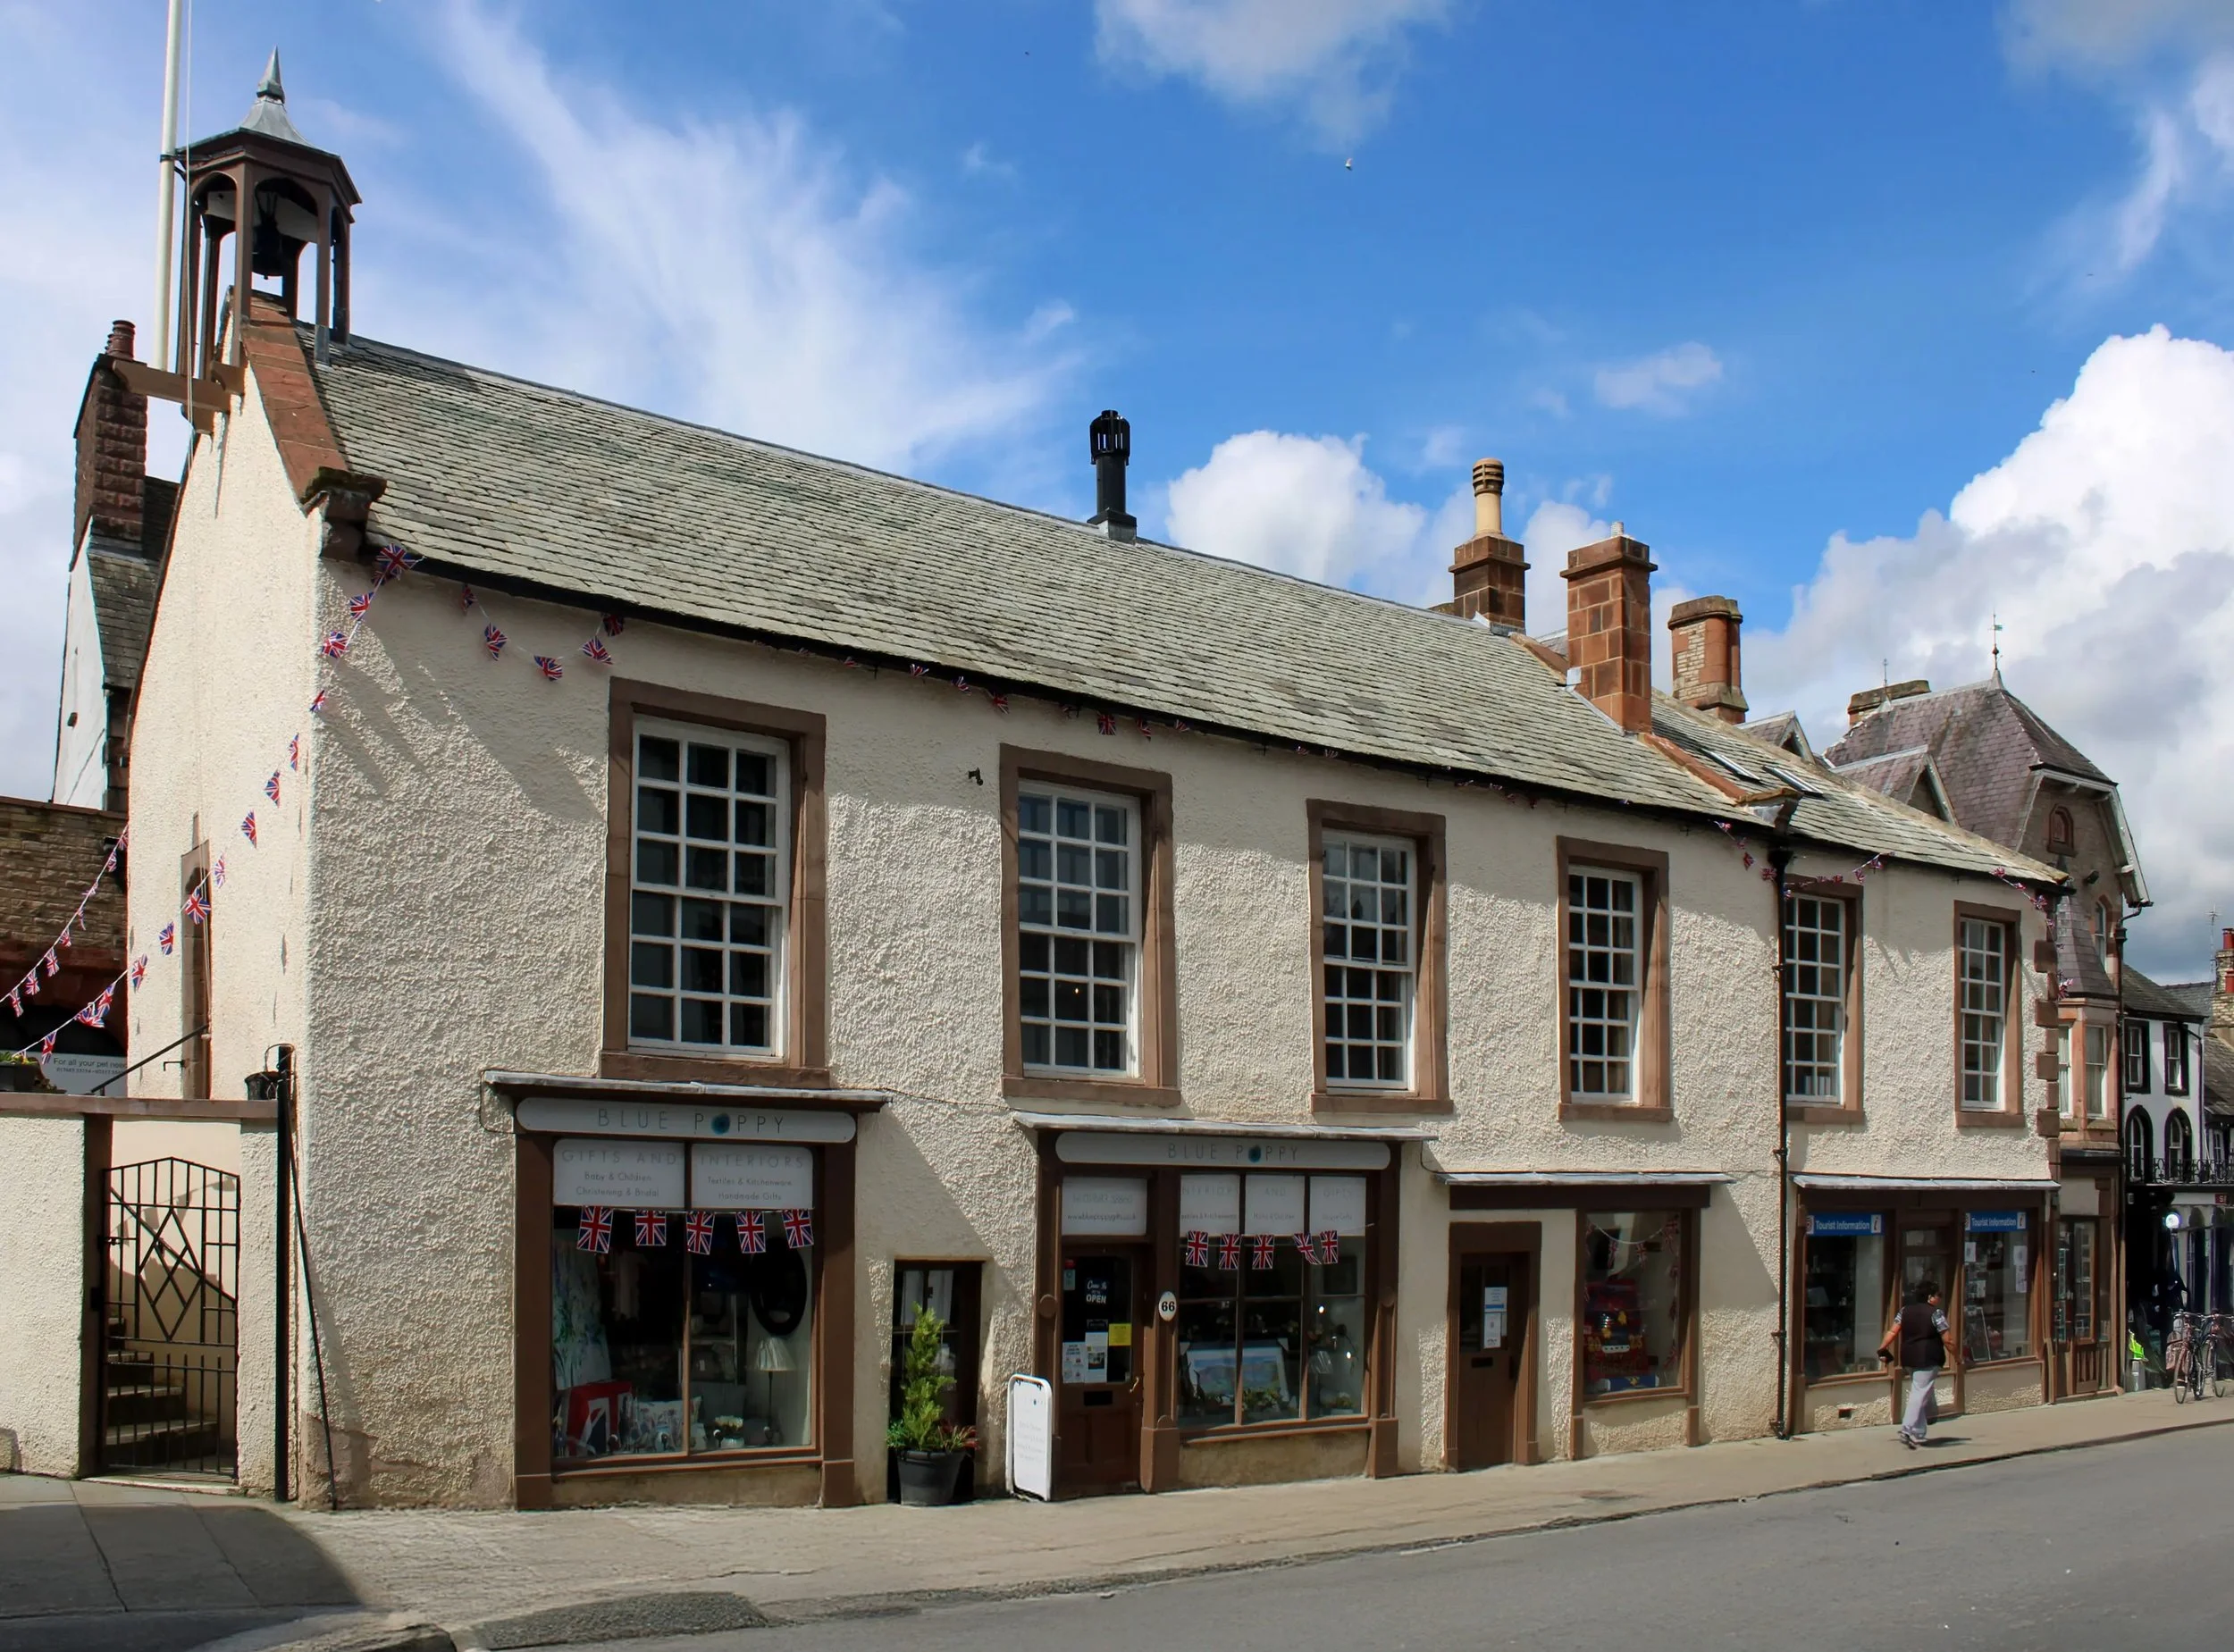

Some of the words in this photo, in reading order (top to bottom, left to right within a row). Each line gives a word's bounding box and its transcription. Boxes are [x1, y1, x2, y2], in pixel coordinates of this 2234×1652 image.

[598, 1108, 668, 1129] BLUE
[693, 1111, 784, 1135] POPPY
[561, 1150, 621, 1163] GIFTS
[636, 1153, 676, 1165] AND
[1168, 1142, 1217, 1160] BLUE
[1236, 1144, 1298, 1163] POPPY
[701, 1153, 803, 1169] INTERIORS
[584, 1171, 605, 1181] Baby
[609, 1172, 615, 1181] &
[617, 1171, 651, 1182] Children
[708, 1176, 735, 1186] Textiles
[575, 1187, 623, 1197] Christening
[635, 1188, 659, 1198] Bridal
[718, 1192, 760, 1201] Handmade
[1816, 1220, 1835, 1230] Tourist
[1836, 1220, 1869, 1230] Information
[1971, 1217, 1988, 1227] Tourist
[1989, 1218, 2017, 1227] Information
[1086, 1293, 1107, 1304] OPEN
[1162, 1301, 1175, 1312] 66
